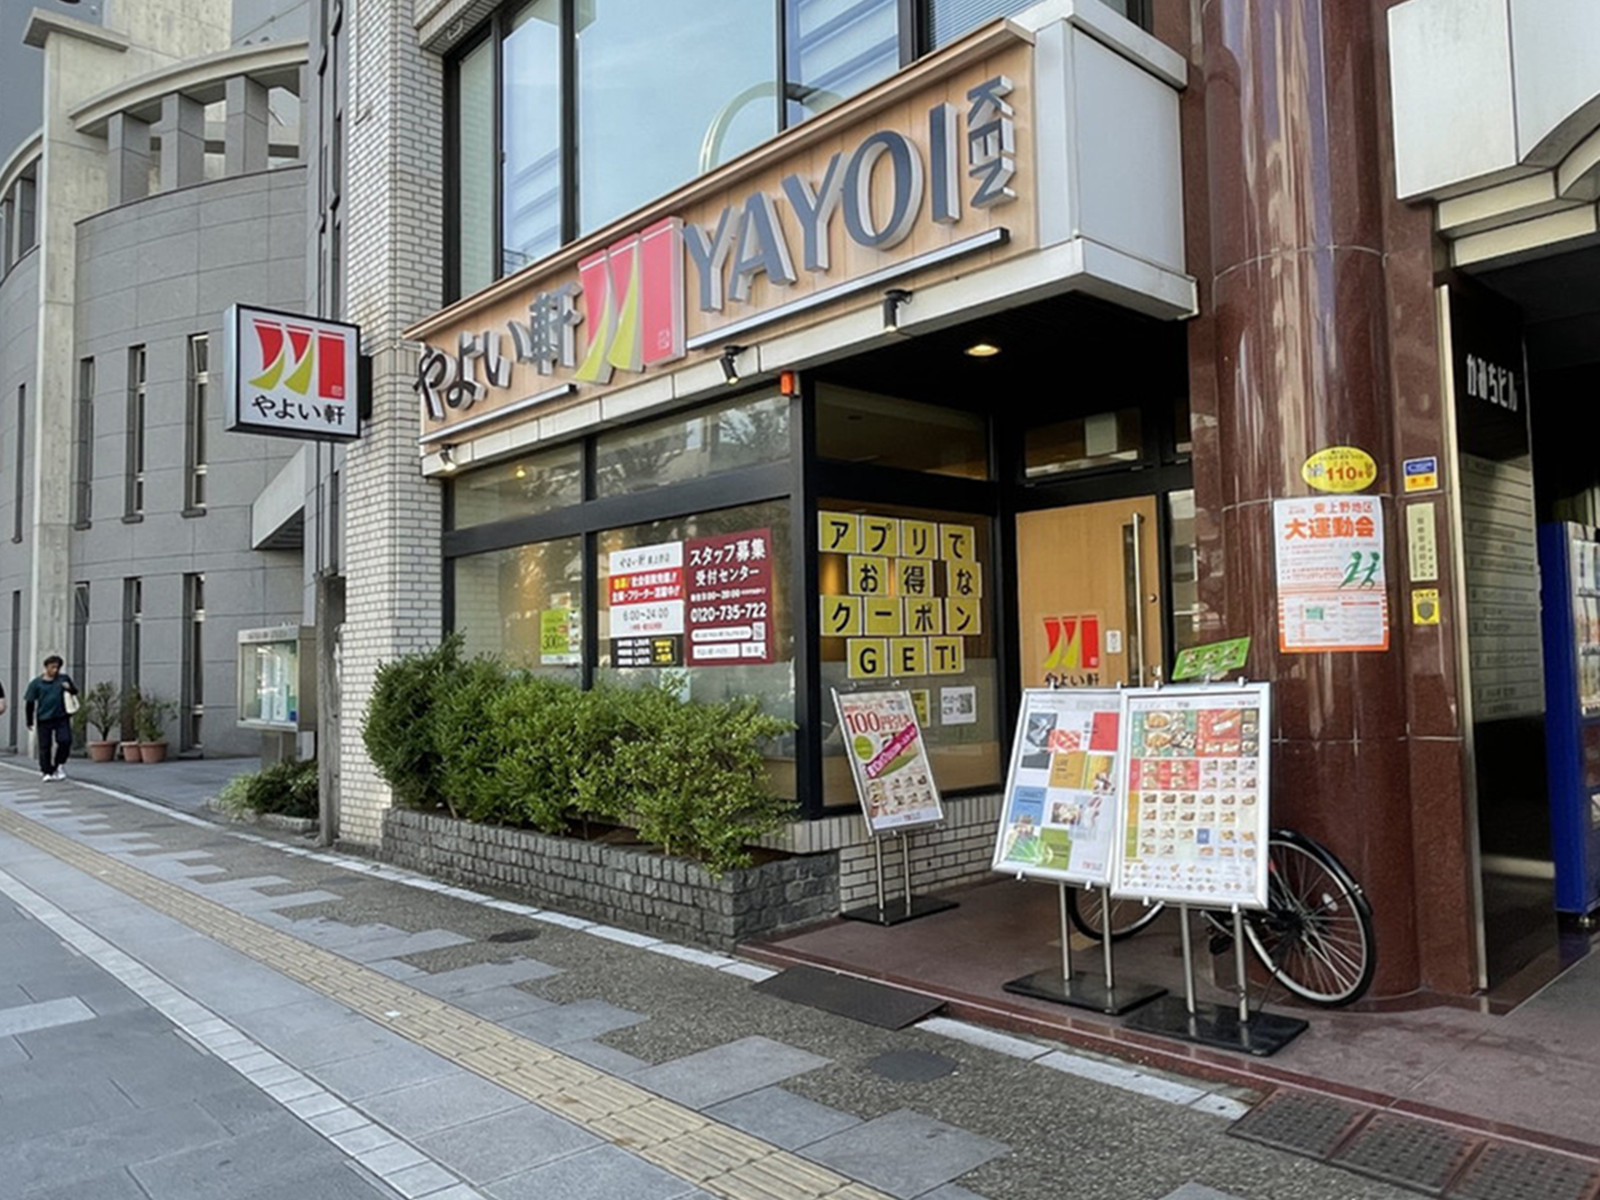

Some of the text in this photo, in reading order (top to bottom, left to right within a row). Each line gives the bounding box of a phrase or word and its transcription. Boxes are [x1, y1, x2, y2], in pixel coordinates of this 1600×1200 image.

[966, 75, 1016, 209] KEN
[684, 102, 960, 313] YAYOI
[413, 282, 584, 421] やよい軒
[251, 394, 346, 426] やよい軒
[829, 520, 966, 559] アプリで
[1284, 515, 1375, 541] 大運動会
[689, 537, 767, 567] スタッフ募集
[695, 565, 760, 587] 受付センター
[859, 563, 973, 596] お得な
[690, 602, 767, 623] 0120-735-722
[832, 601, 972, 633] クーポン
[859, 645, 957, 674] GET!
